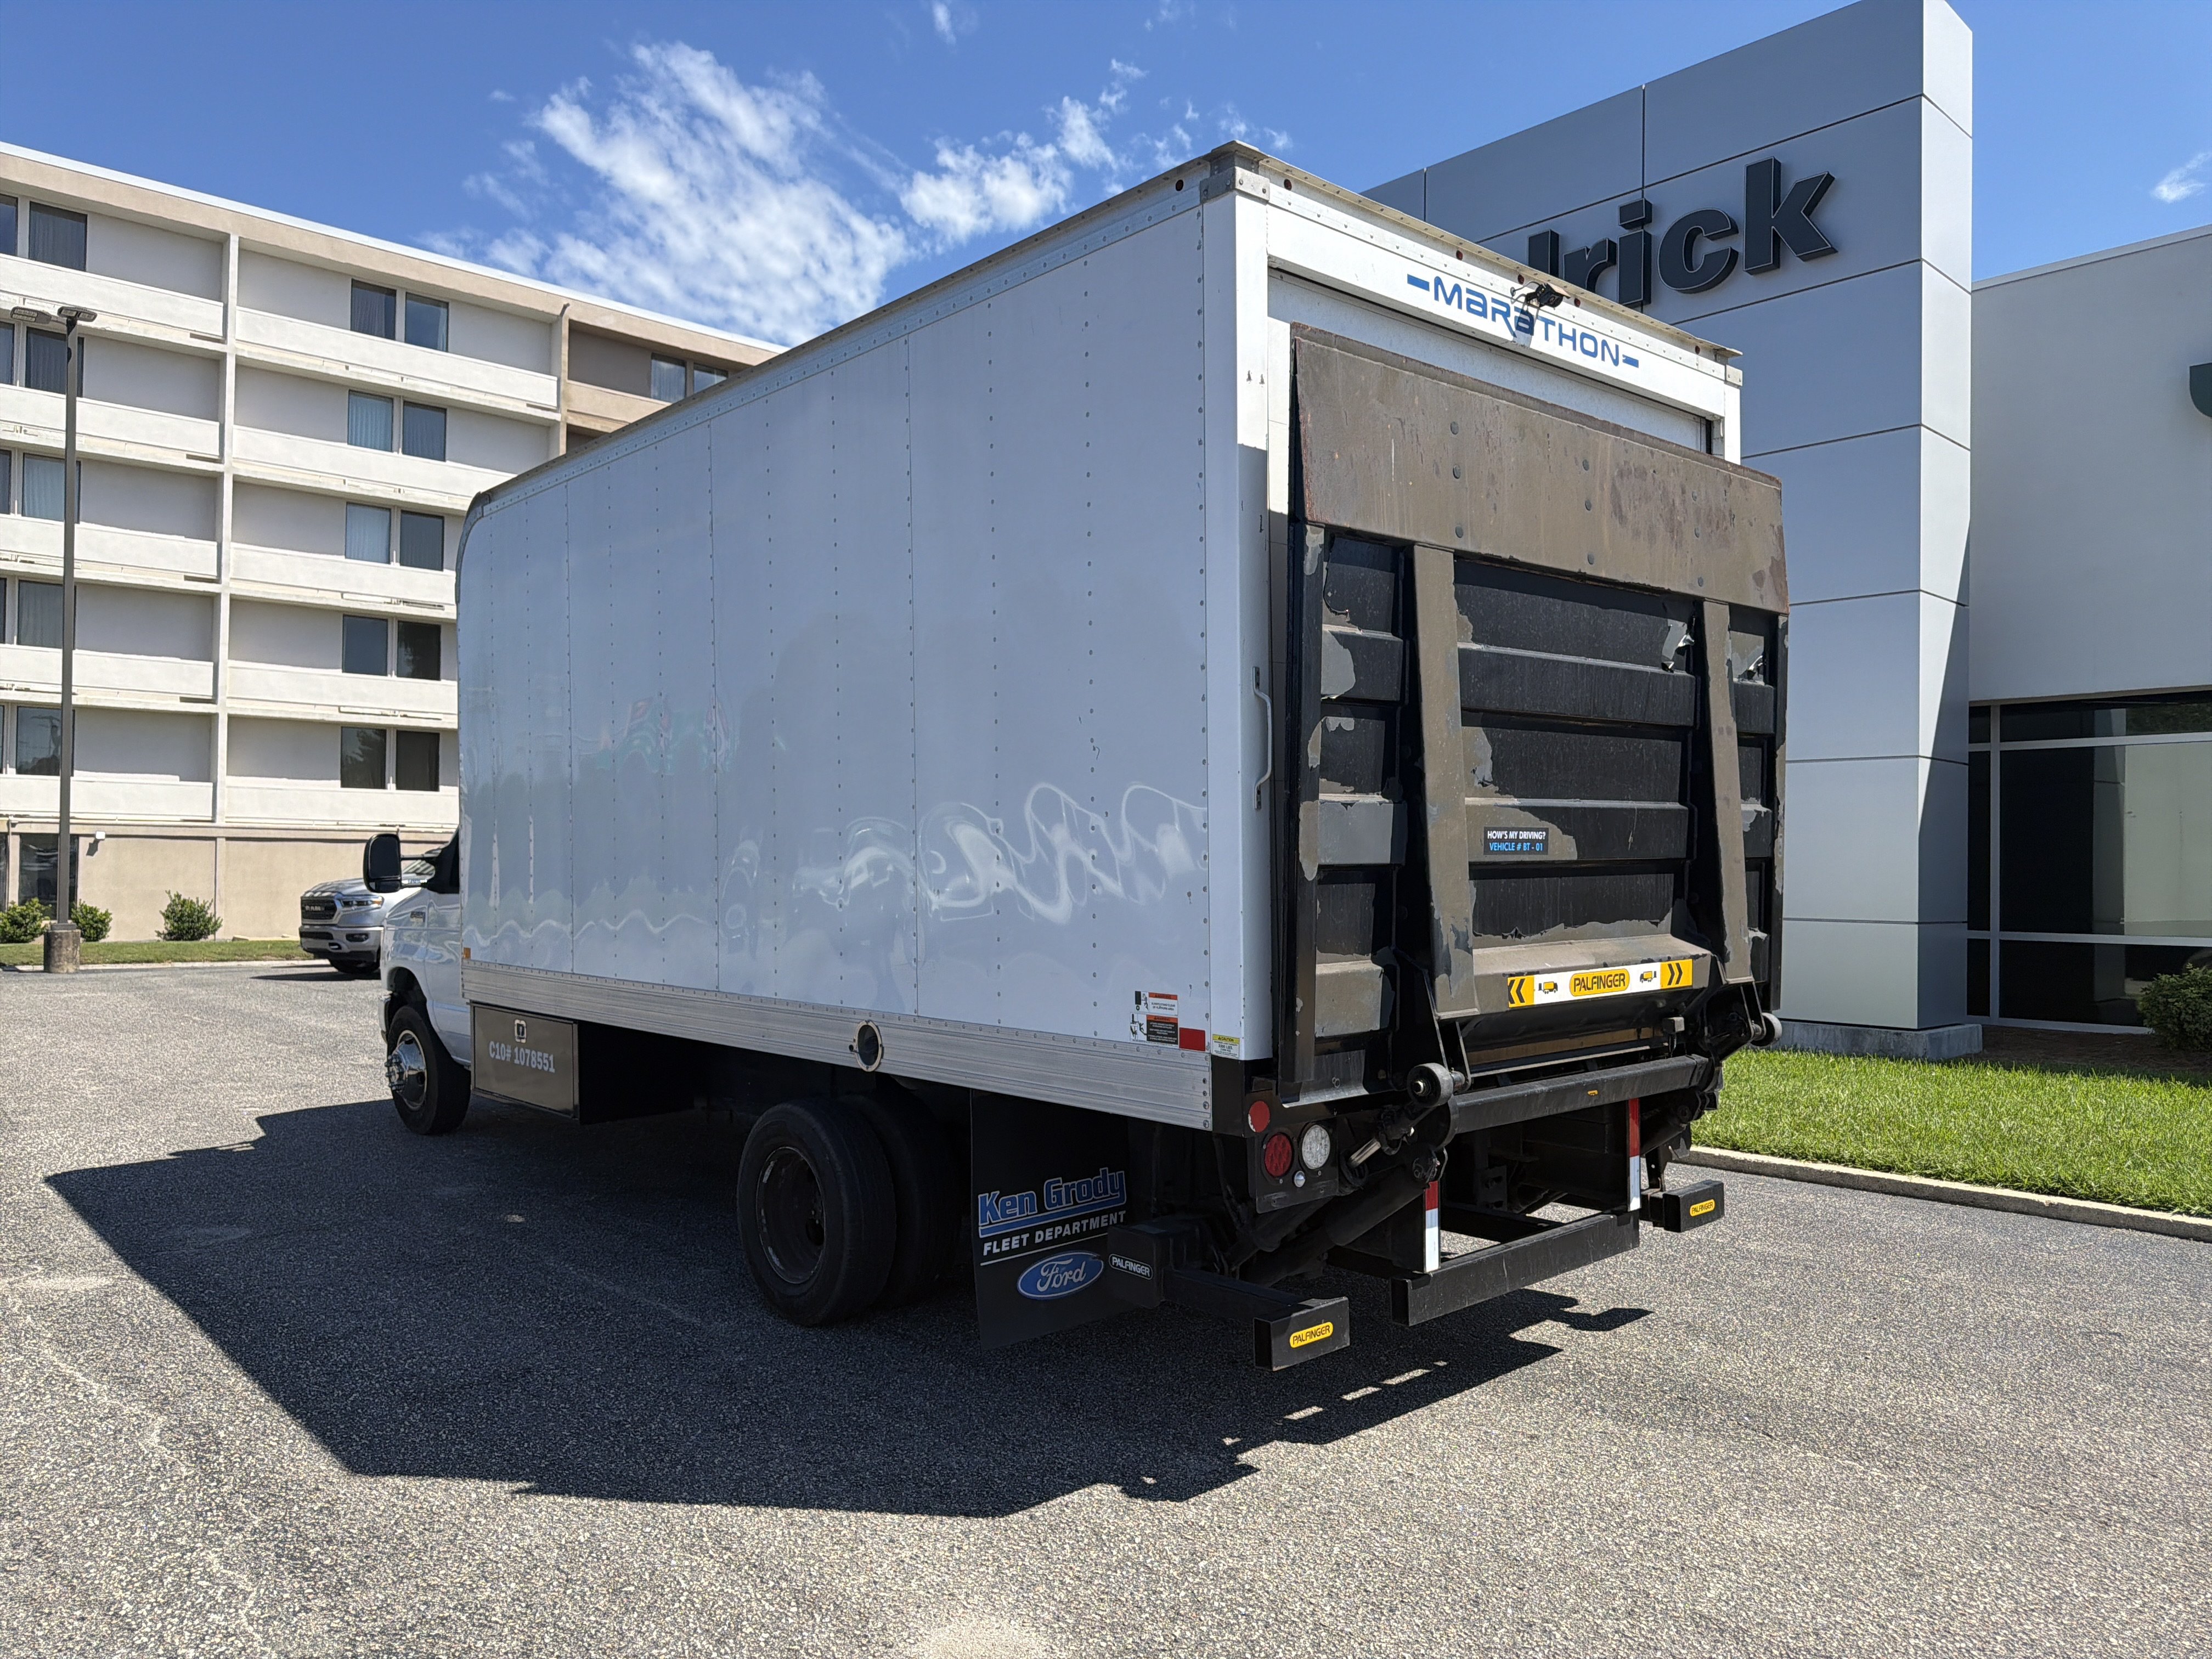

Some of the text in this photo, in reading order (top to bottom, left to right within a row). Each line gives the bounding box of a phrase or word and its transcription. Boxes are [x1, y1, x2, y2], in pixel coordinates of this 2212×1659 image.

[1487, 831, 1546, 840] HOW'S MY DRIVING?
[1489, 842, 1515, 851] VEHICLE
[1516, 842, 1522, 851] #
[1573, 967, 1626, 993] PALFINGER
[514, 1046, 555, 1073] 1078551
[978, 1166, 1127, 1226] Ken Grody
[1691, 1201, 1713, 1215] PALFINGER
[983, 1210, 1126, 1256] FLEET DEPARTMENT
[1036, 1258, 1087, 1292] Ford
[1111, 1256, 1151, 1277] PALFINGER
[1293, 1324, 1330, 1346] PALFINGER
